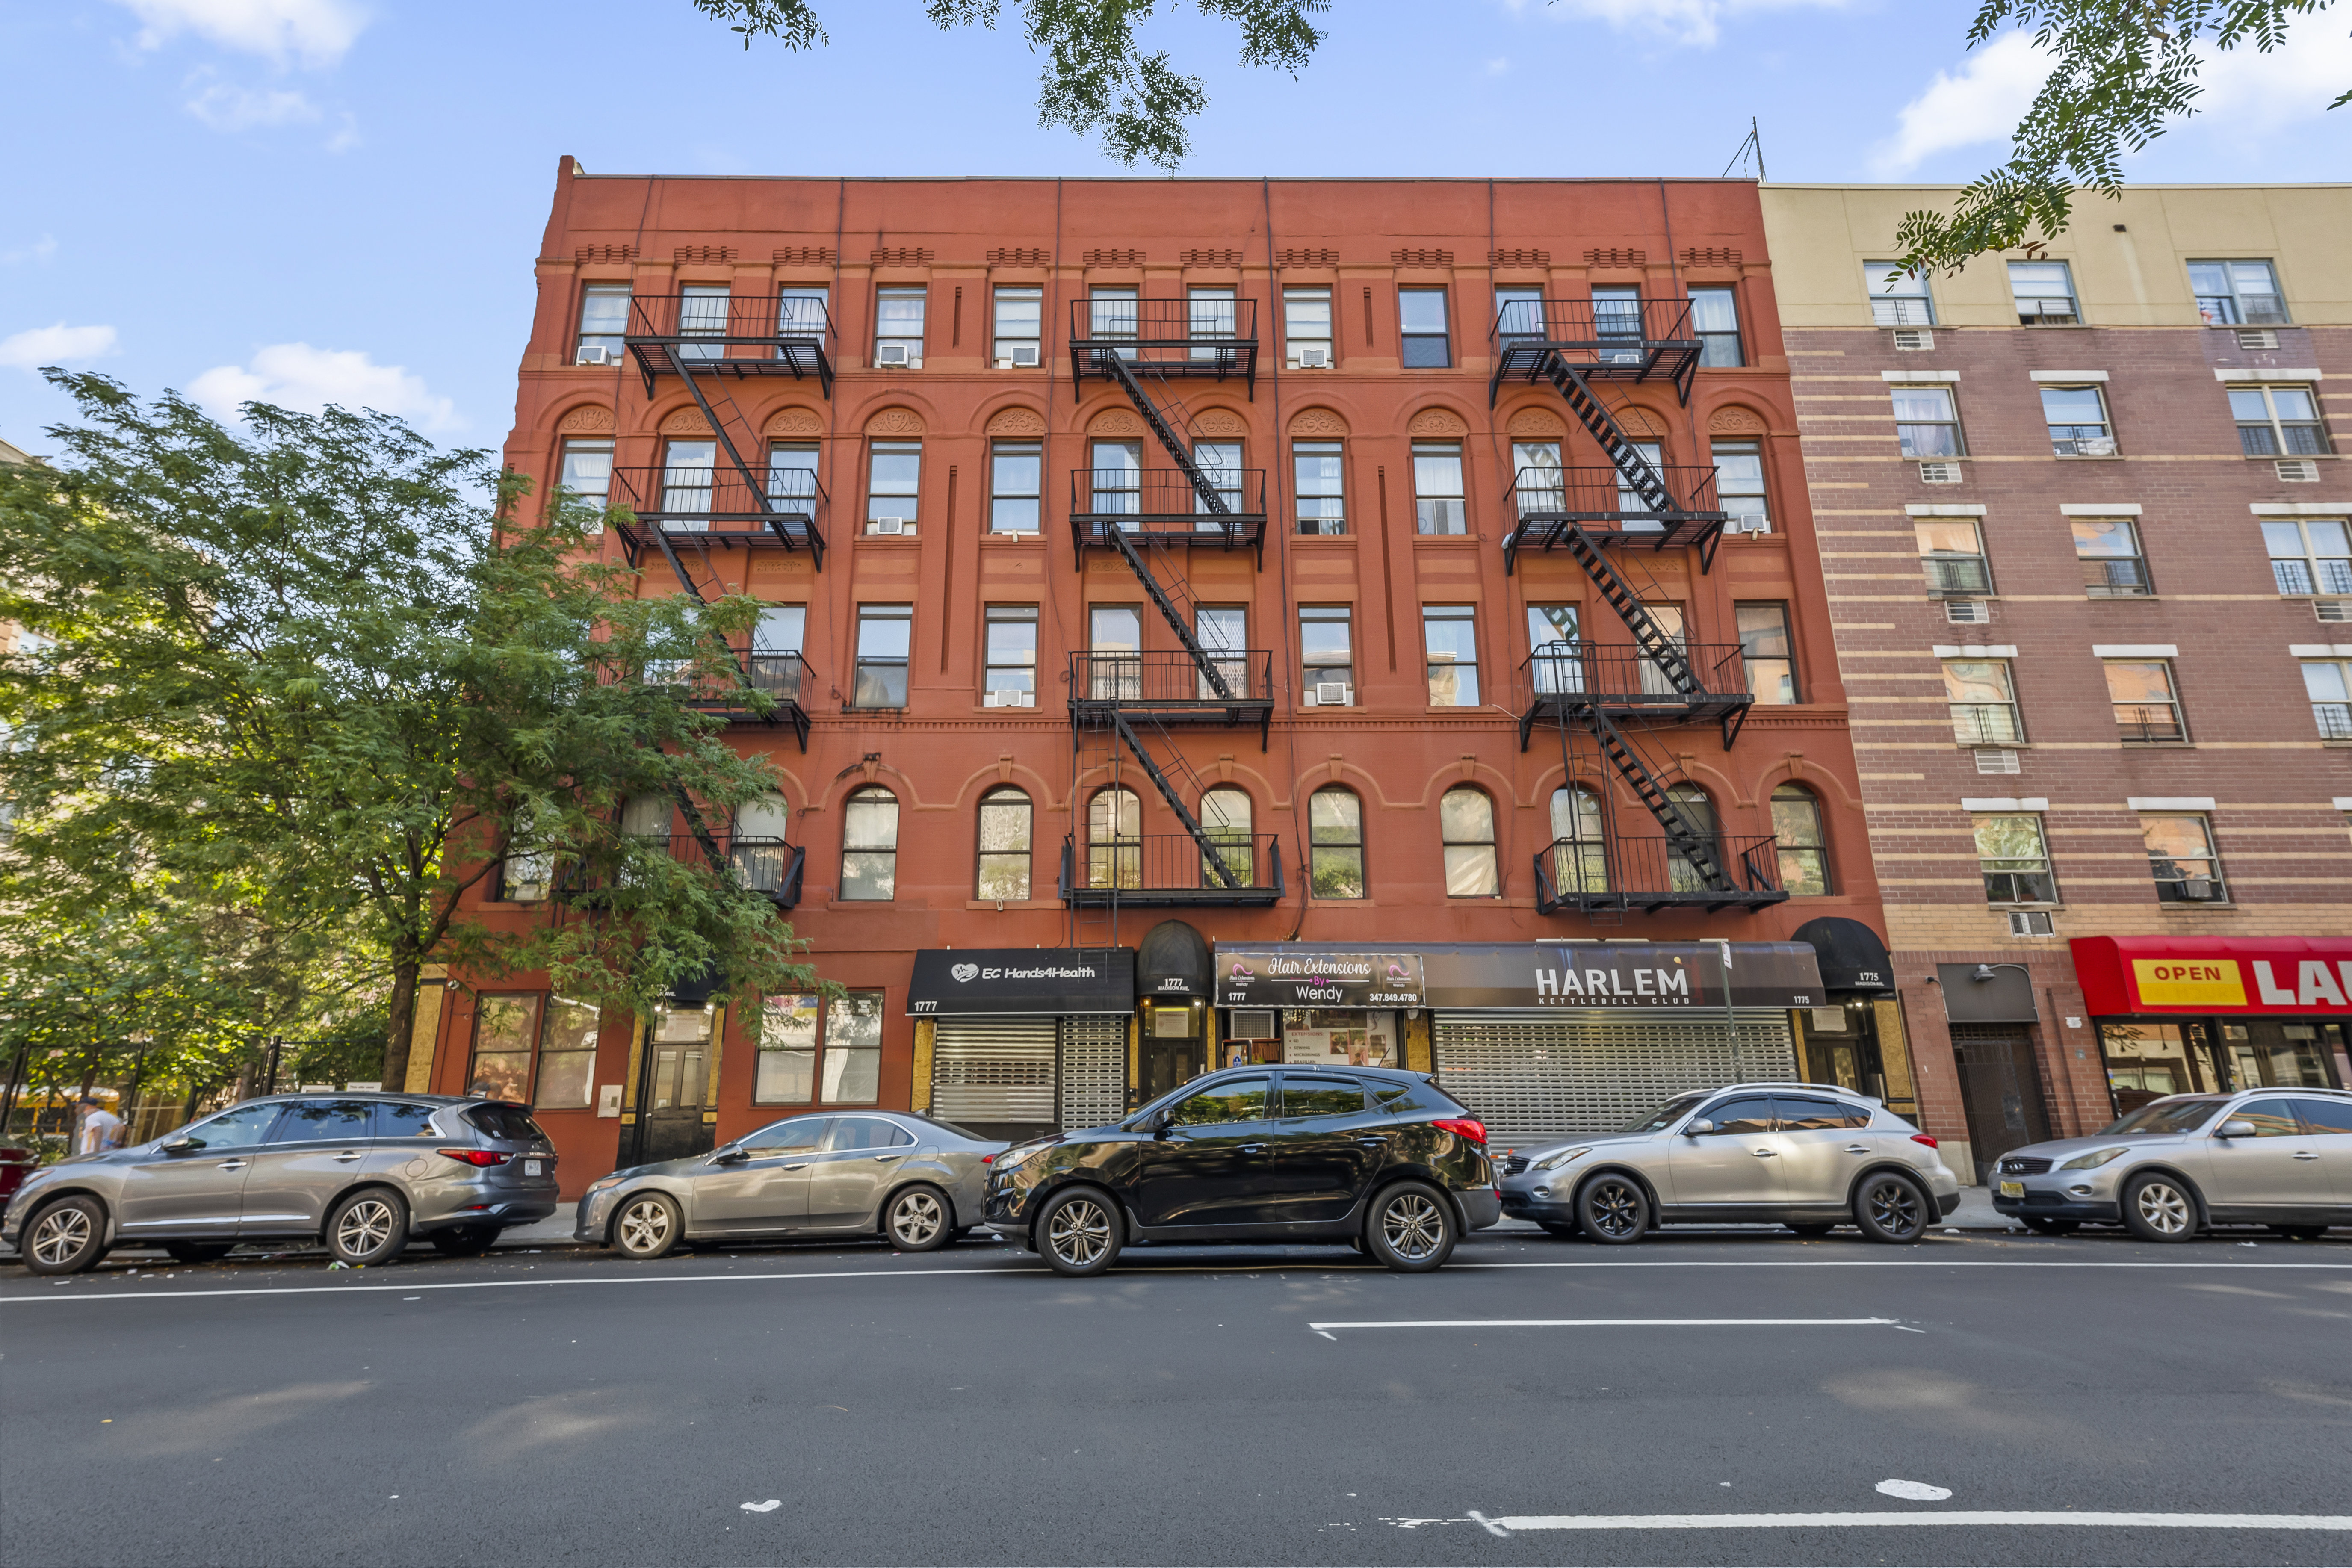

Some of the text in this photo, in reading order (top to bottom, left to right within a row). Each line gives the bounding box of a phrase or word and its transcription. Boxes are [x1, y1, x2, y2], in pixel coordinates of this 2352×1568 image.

[1268, 957, 1371, 974] Hair Extensions
[982, 967, 1095, 979] EC Hands4Health
[1859, 972, 1879, 981] 1775
[2154, 966, 2222, 980] OPEN
[1164, 978, 1183, 986] 1777
[1314, 976, 1325, 987] By
[1536, 969, 1688, 995] HARLEM
[1228, 992, 1246, 1001] 1777
[1296, 986, 1343, 1002] Wendy
[1370, 993, 1417, 1001] 347.849.4780
[914, 1001, 937, 1011] 1777
